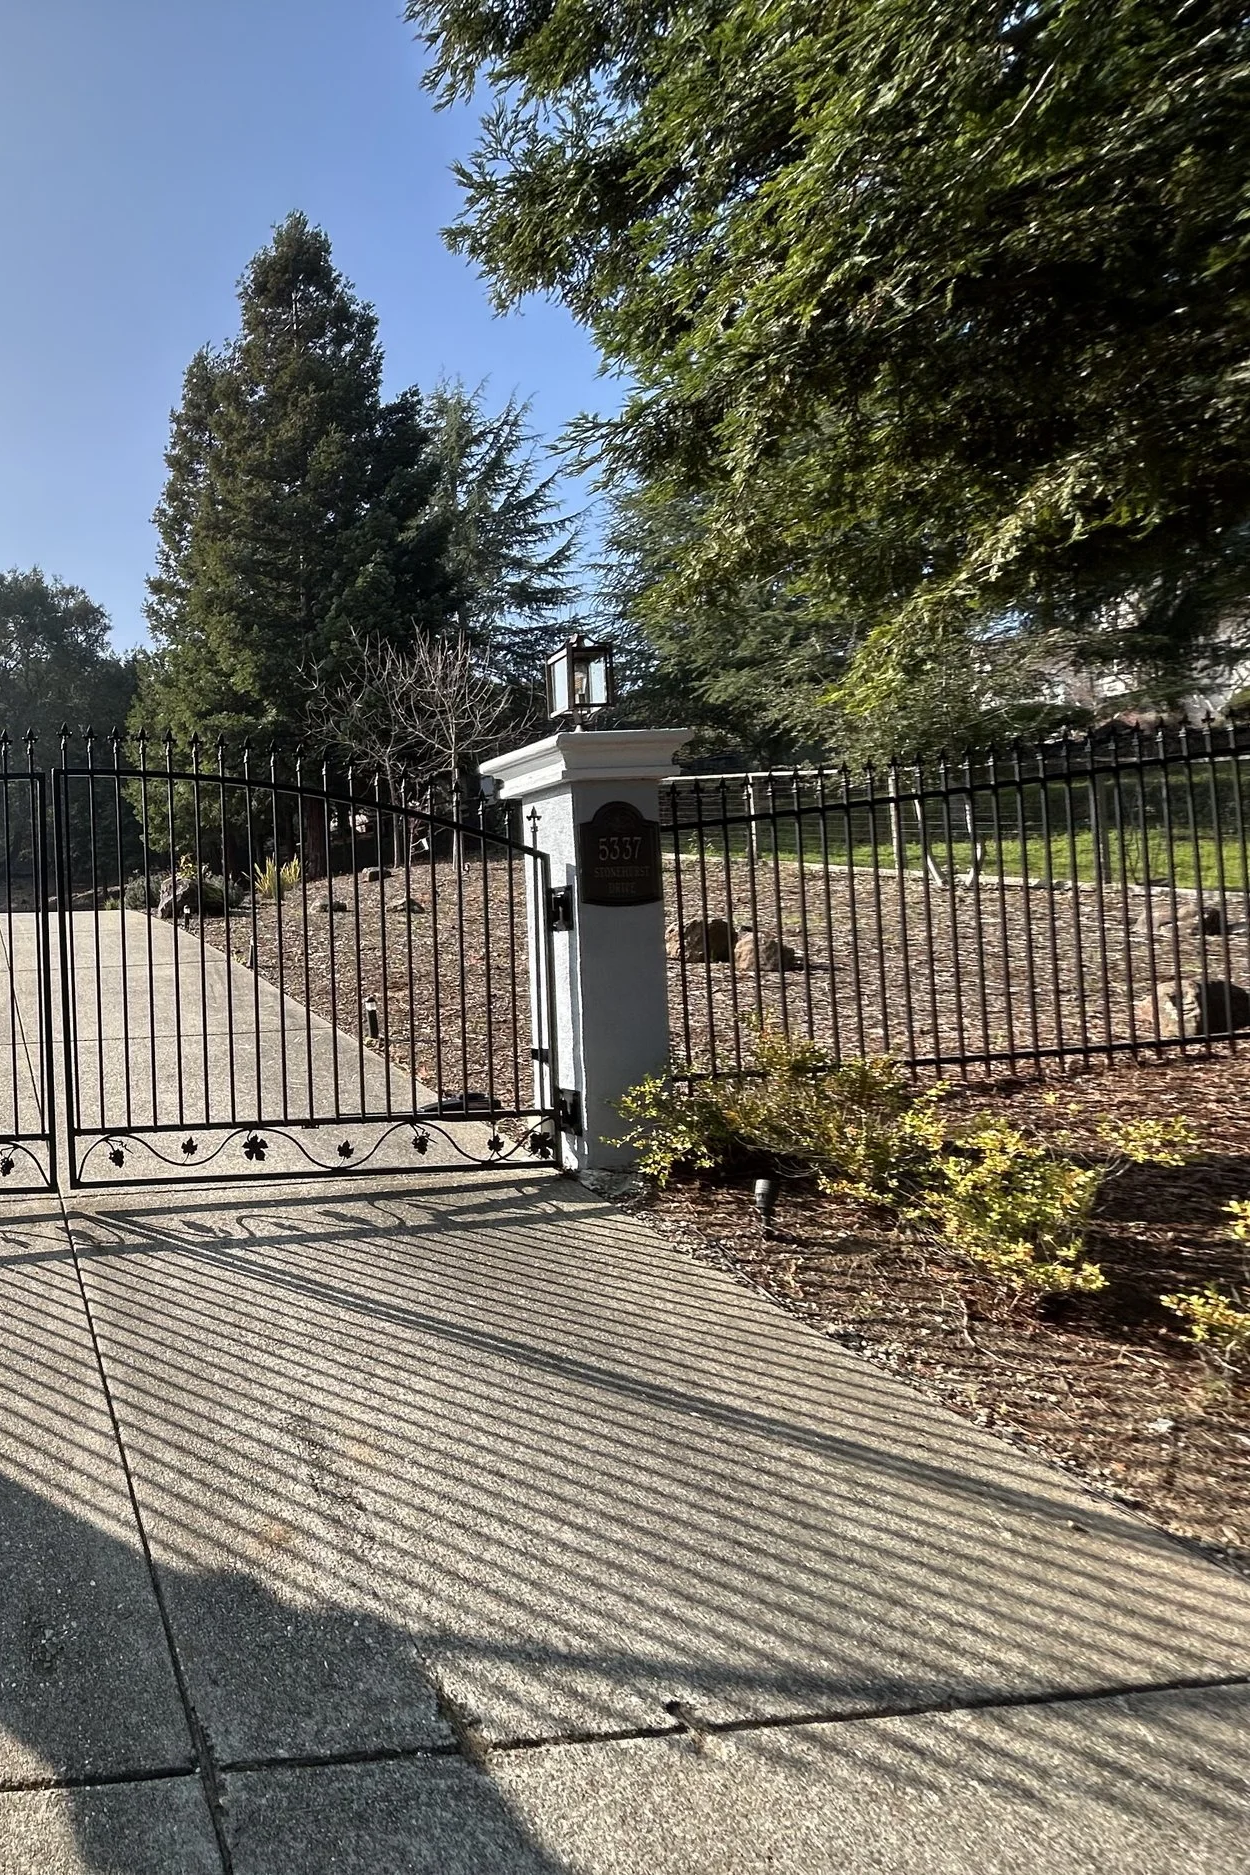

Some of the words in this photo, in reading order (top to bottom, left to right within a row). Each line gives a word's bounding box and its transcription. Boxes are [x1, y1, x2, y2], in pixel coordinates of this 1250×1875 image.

[598, 836, 642, 861] 5337
[593, 865, 651, 878] STONEHURST
[607, 882, 637, 894] DRIVE
